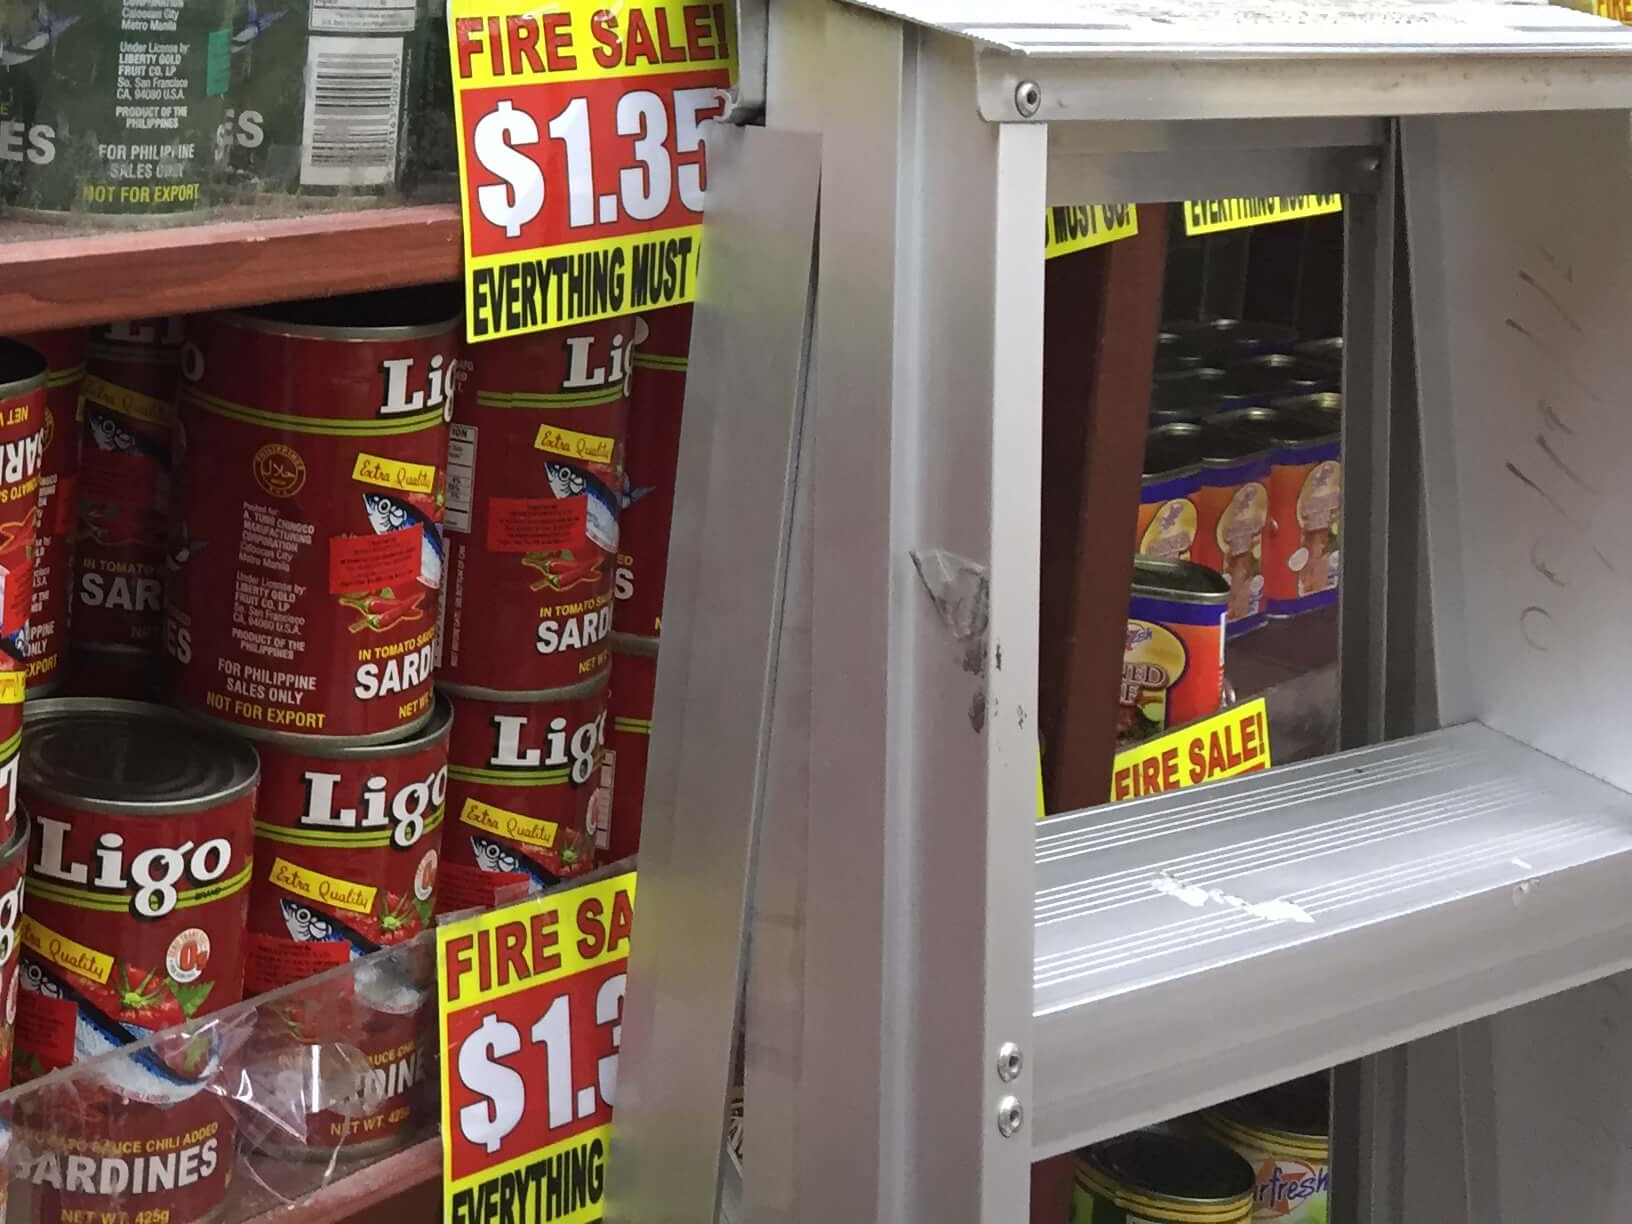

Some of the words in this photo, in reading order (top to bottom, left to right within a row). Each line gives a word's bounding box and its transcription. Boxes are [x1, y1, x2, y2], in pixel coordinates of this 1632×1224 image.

[455, 15, 578, 79] FIRE
[590, 2, 730, 72] SALE!
[98, 144, 127, 161] FOR
[120, 185, 150, 203] FOR
[153, 183, 201, 202] EXPORT
[472, 248, 624, 336] EVERYTHING
[630, 238, 689, 310] MUST
[217, 657, 242, 675] FOR
[243, 664, 318, 691] PHILIPPINE
[226, 677, 267, 700] SALES
[268, 685, 304, 706] ONLY
[206, 691, 235, 714] NOT
[235, 700, 263, 721] FOR
[266, 705, 327, 730] EXPORT
[1188, 712, 1266, 785] SALE!
[32, 815, 233, 918] Ligo
[317, 878, 370, 911] Quality
[46, 934, 106, 979] Quality
[445, 921, 564, 1001] FIRE
